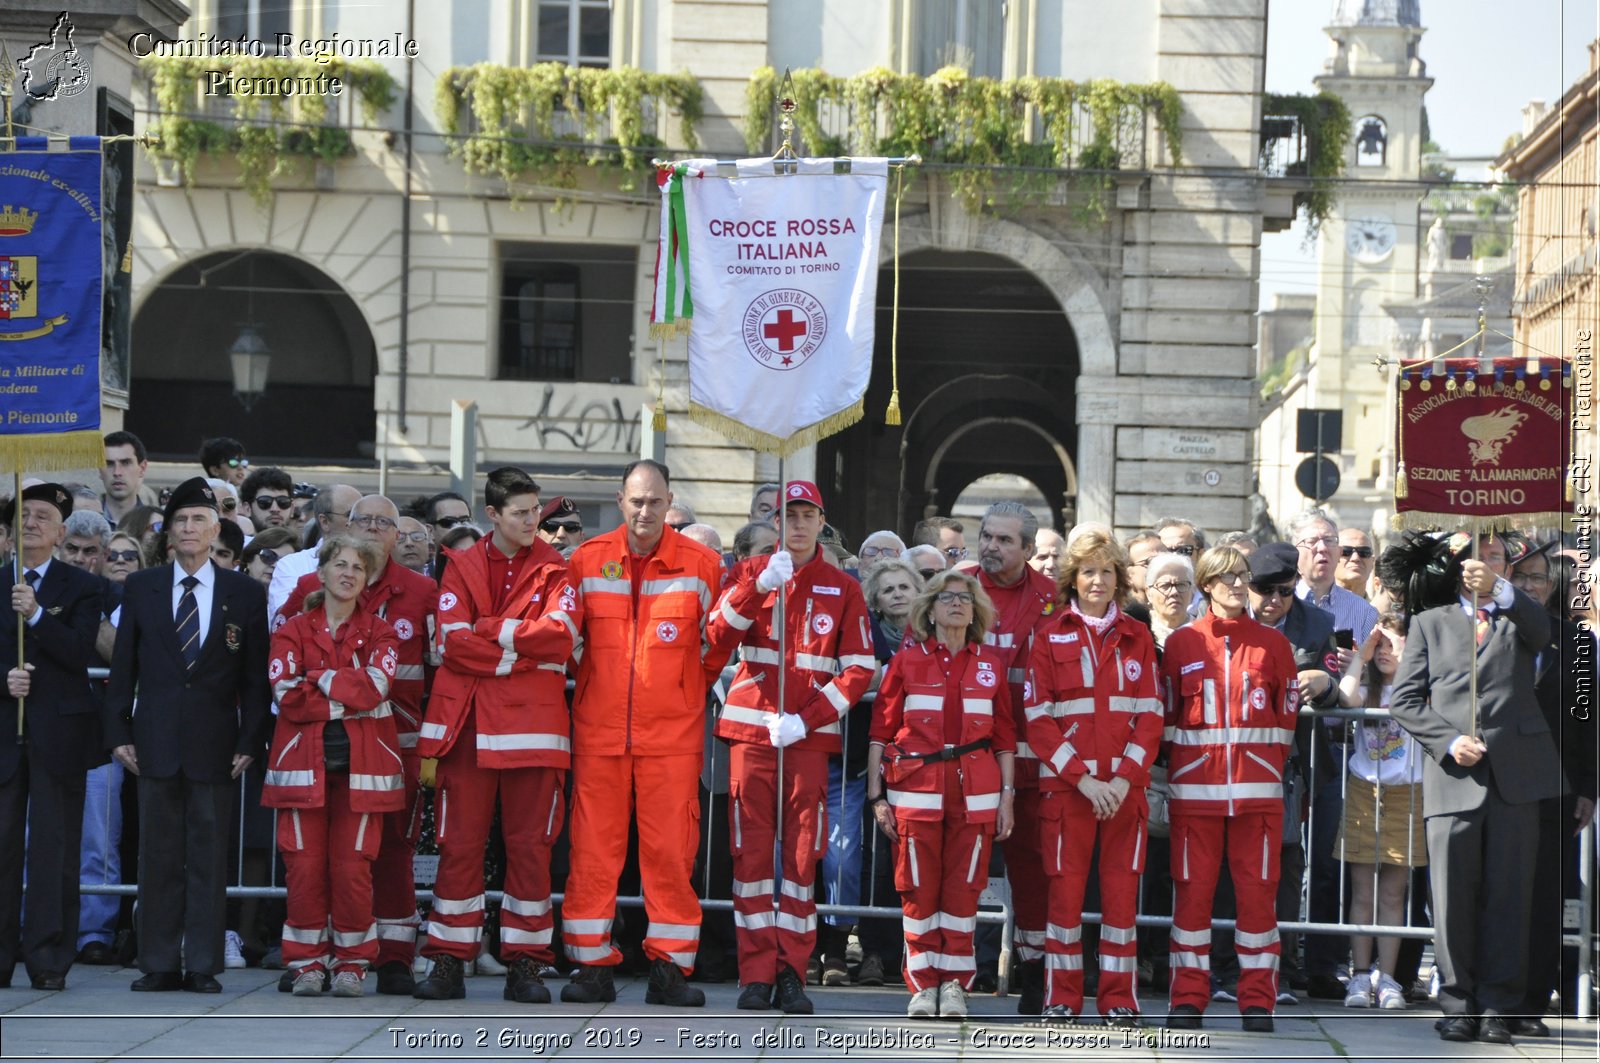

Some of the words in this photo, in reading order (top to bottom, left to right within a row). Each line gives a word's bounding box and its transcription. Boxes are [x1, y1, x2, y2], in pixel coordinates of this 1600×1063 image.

[0, 164, 50, 181] zionale
[709, 219, 777, 238] CROCE
[787, 217, 856, 237] ROSSA
[737, 241, 828, 260] ITALIANA
[727, 265, 782, 276] COMITATO
[785, 265, 796, 275] DI
[801, 262, 840, 273] TORINO
[757, 298, 769, 311] DI
[768, 291, 806, 307] GINEVRA
[805, 301, 817, 312] 22
[745, 307, 772, 361] CONVENZIONE
[811, 311, 825, 341] AGOSTO
[14, 365, 68, 378] Militare
[71, 364, 85, 376] di
[1503, 385, 1565, 421] BERSAGLIER
[7, 410, 78, 424] Piemonte
[1173, 446, 1216, 455] CASTELLO
[1411, 467, 1461, 482] SEZIONE
[1445, 489, 1526, 506] TORINO
